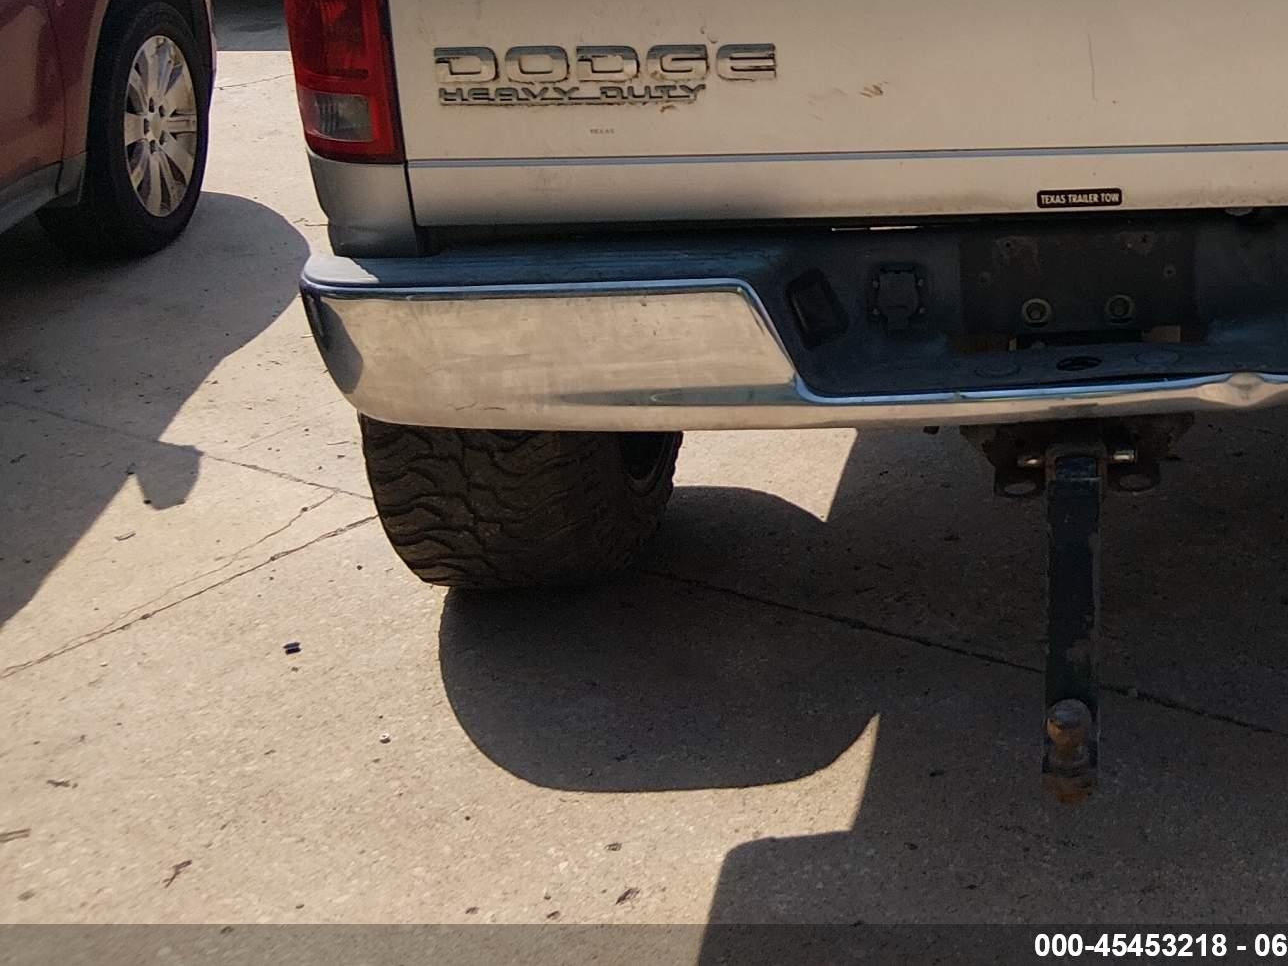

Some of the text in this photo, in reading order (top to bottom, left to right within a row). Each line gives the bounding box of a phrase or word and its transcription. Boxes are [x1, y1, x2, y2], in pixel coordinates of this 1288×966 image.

[433, 42, 778, 84] DODGE
[438, 84, 707, 103] HEAVY DUTY
[1040, 192, 1120, 205] TEXAS TRAILER TOW
